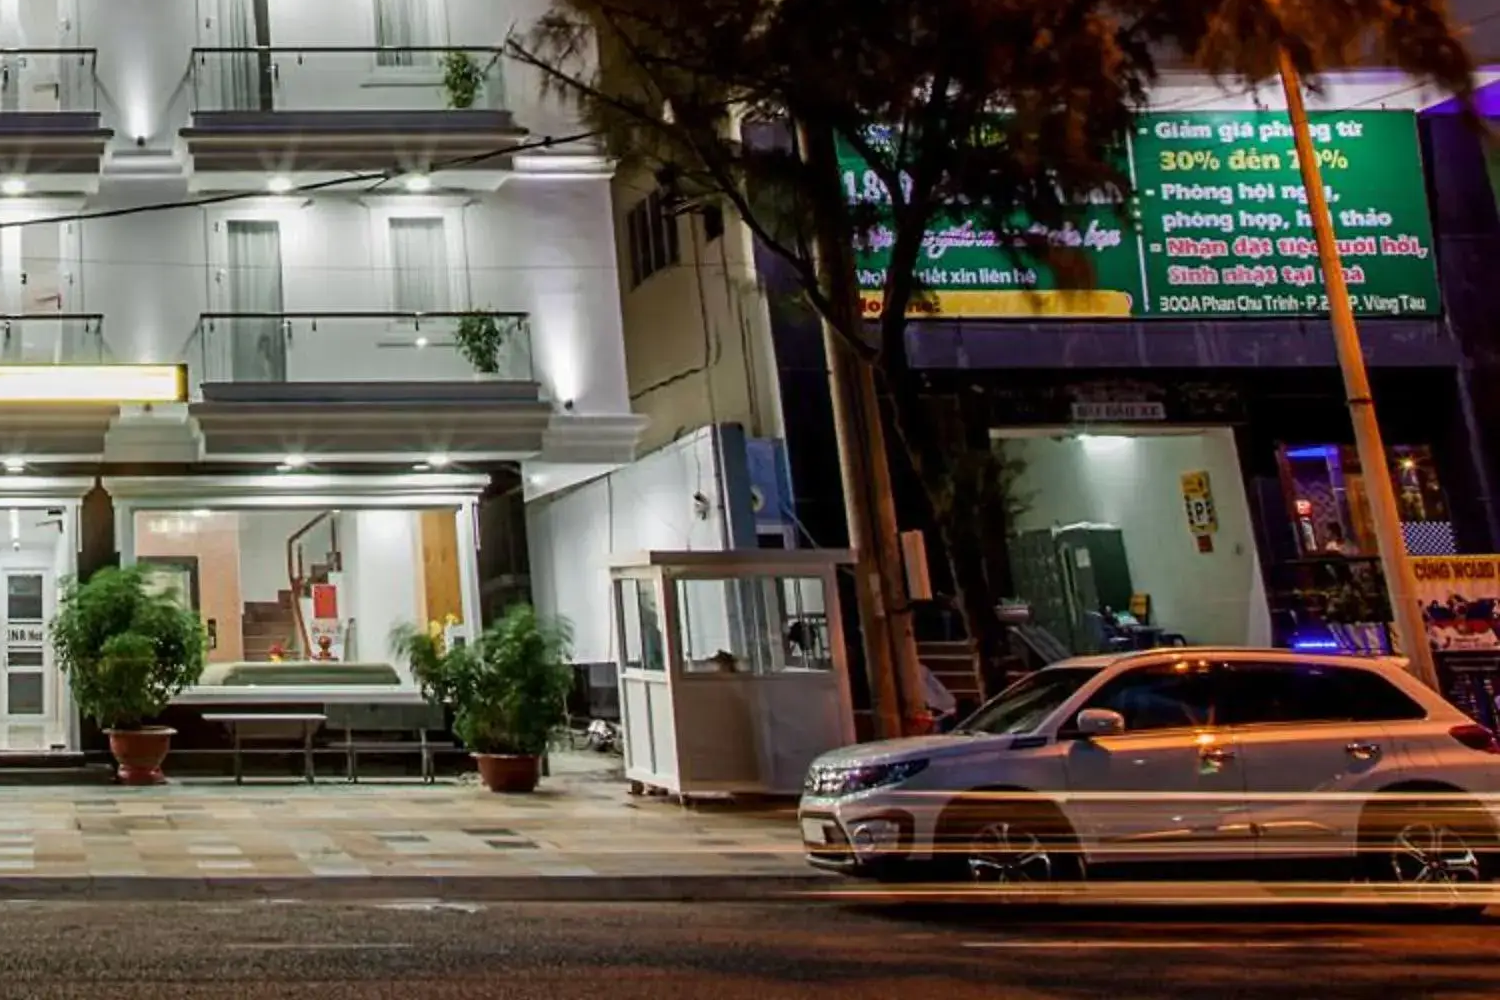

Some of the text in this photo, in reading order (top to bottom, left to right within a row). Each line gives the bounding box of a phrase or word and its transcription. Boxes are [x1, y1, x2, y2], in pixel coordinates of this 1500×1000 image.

[1259, 120, 1332, 142] phng
[1160, 151, 1220, 171] 30%
[1161, 181, 1234, 204] Phòng
[1161, 210, 1234, 232] phòng
[1168, 265, 1219, 285] Sinh
[1159, 296, 1199, 312] 300A
[1201, 295, 1236, 311] Phan
